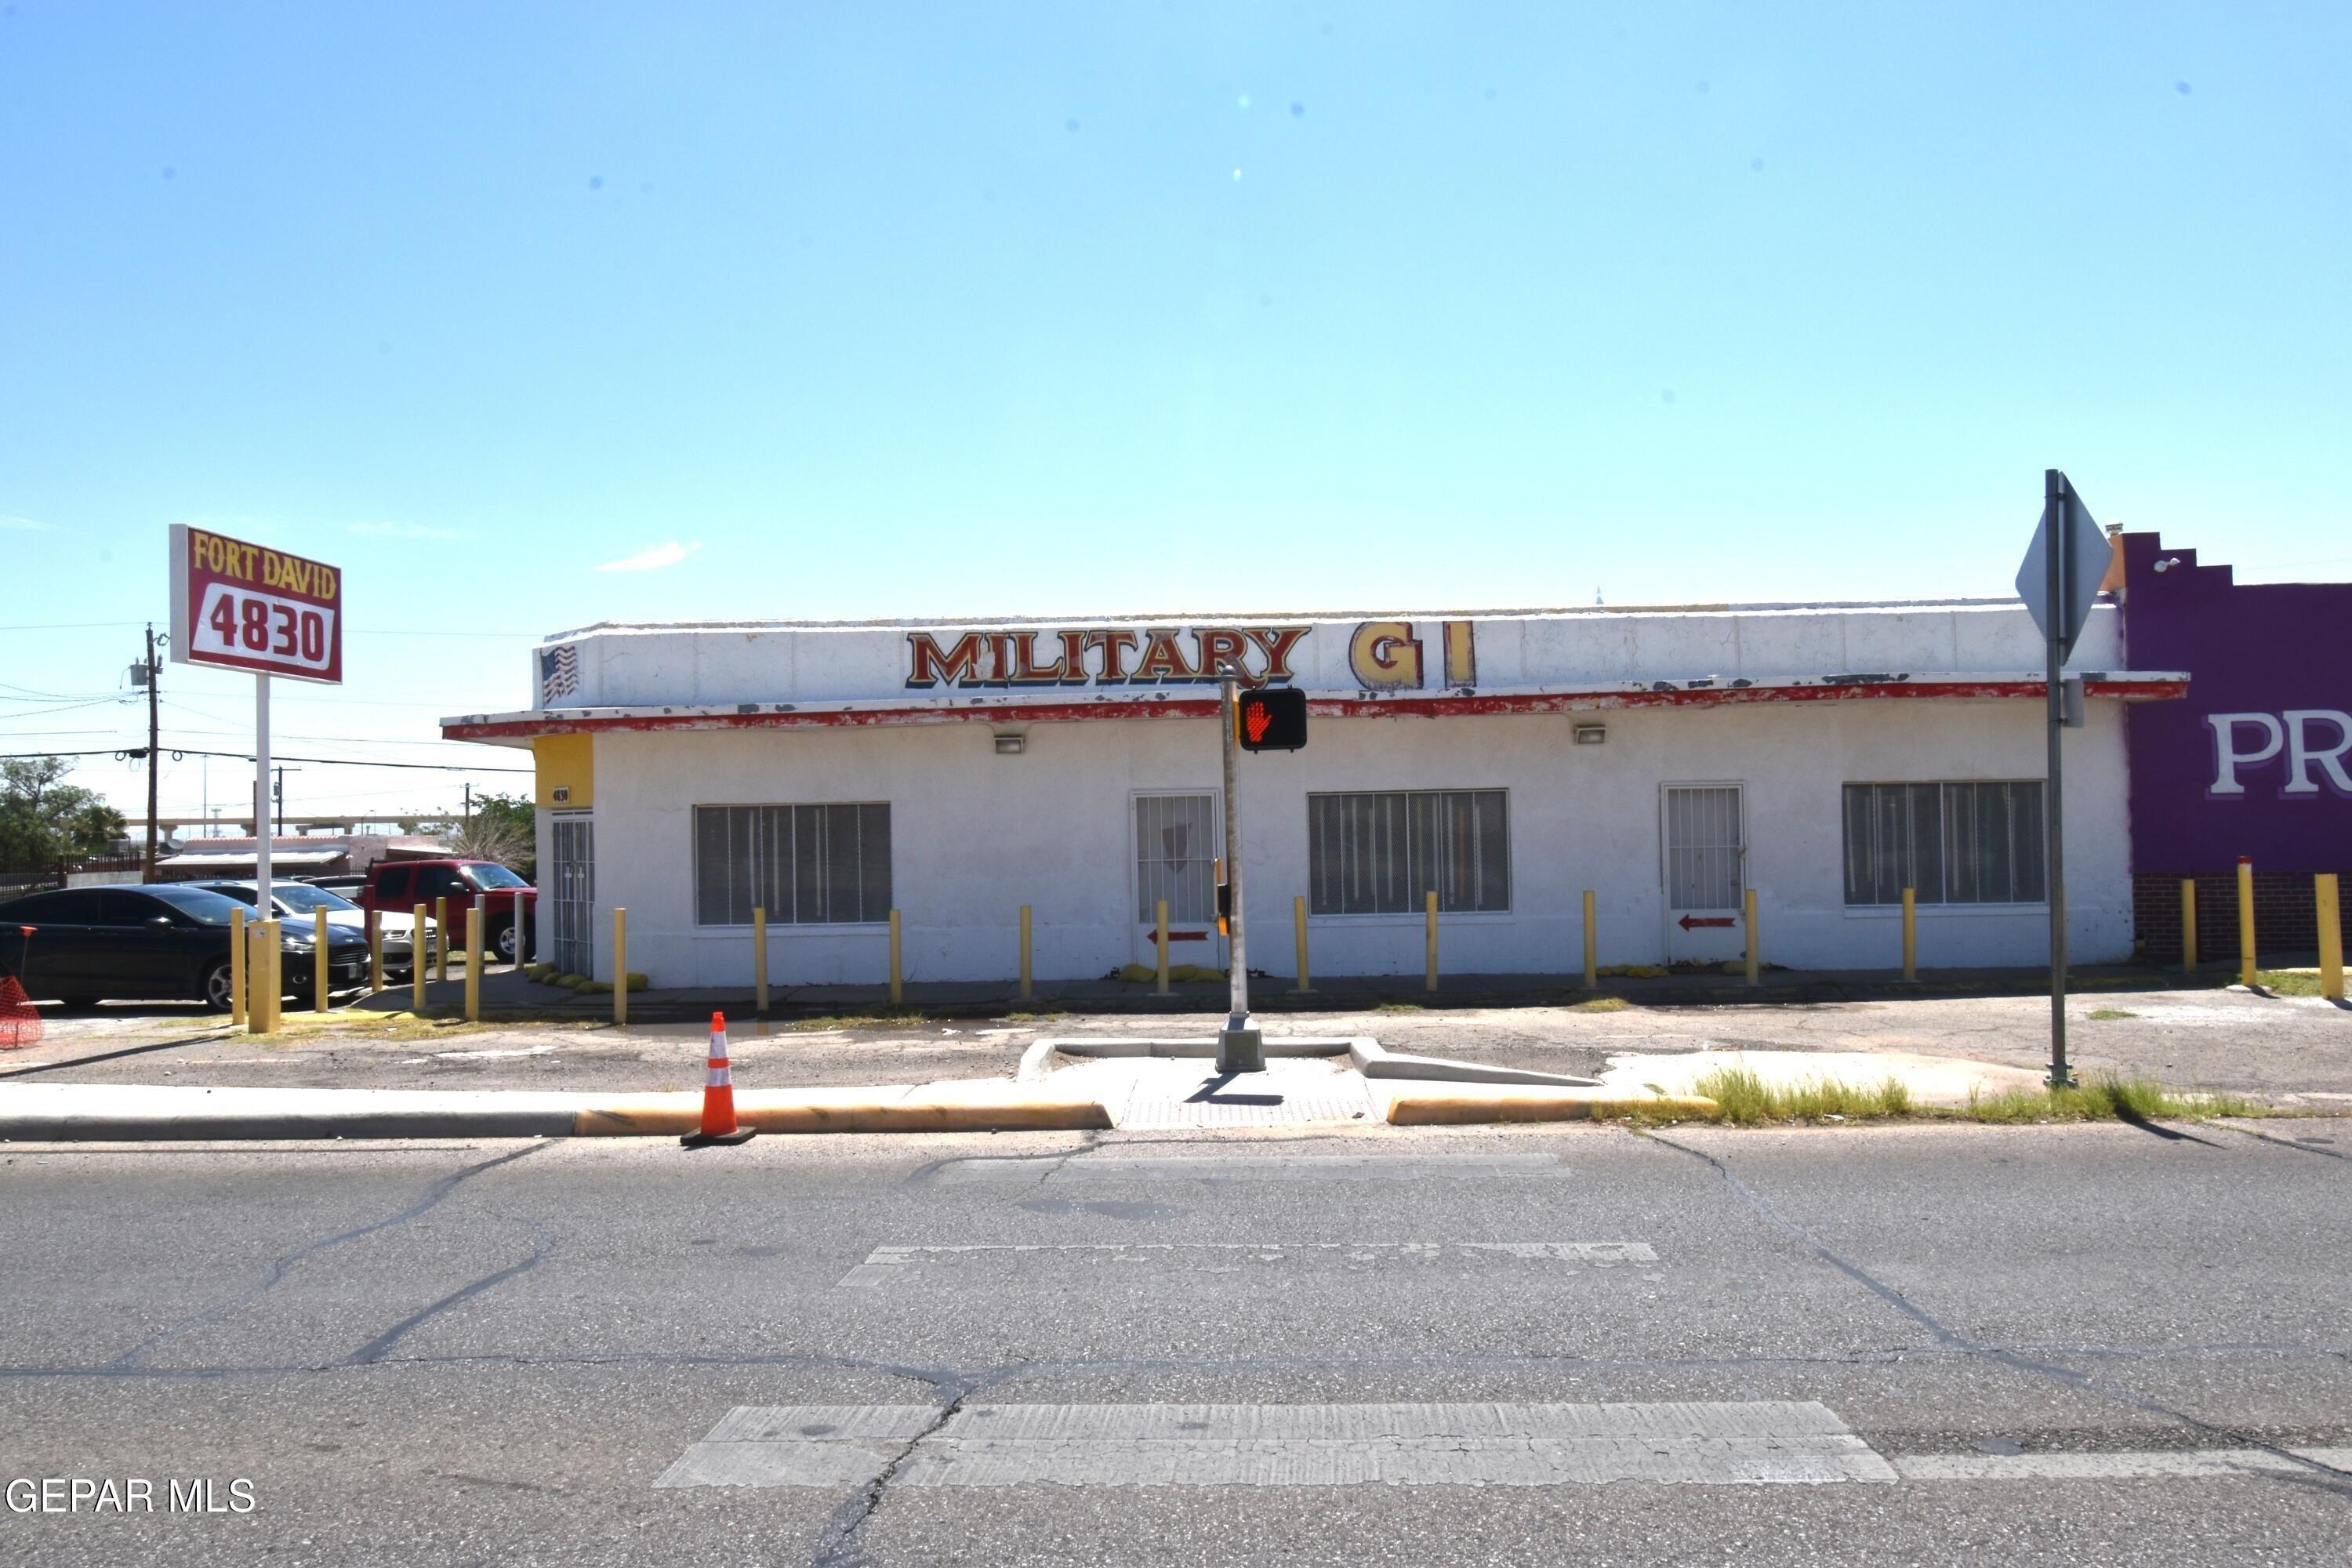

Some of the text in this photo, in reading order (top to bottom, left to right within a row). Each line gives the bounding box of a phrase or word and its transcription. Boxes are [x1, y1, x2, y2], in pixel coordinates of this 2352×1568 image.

[194, 532, 336, 600] FORT DAVID
[210, 593, 324, 662] 4830
[905, 619, 1477, 691] MILITARY GI
[553, 789, 568, 801] 4830
